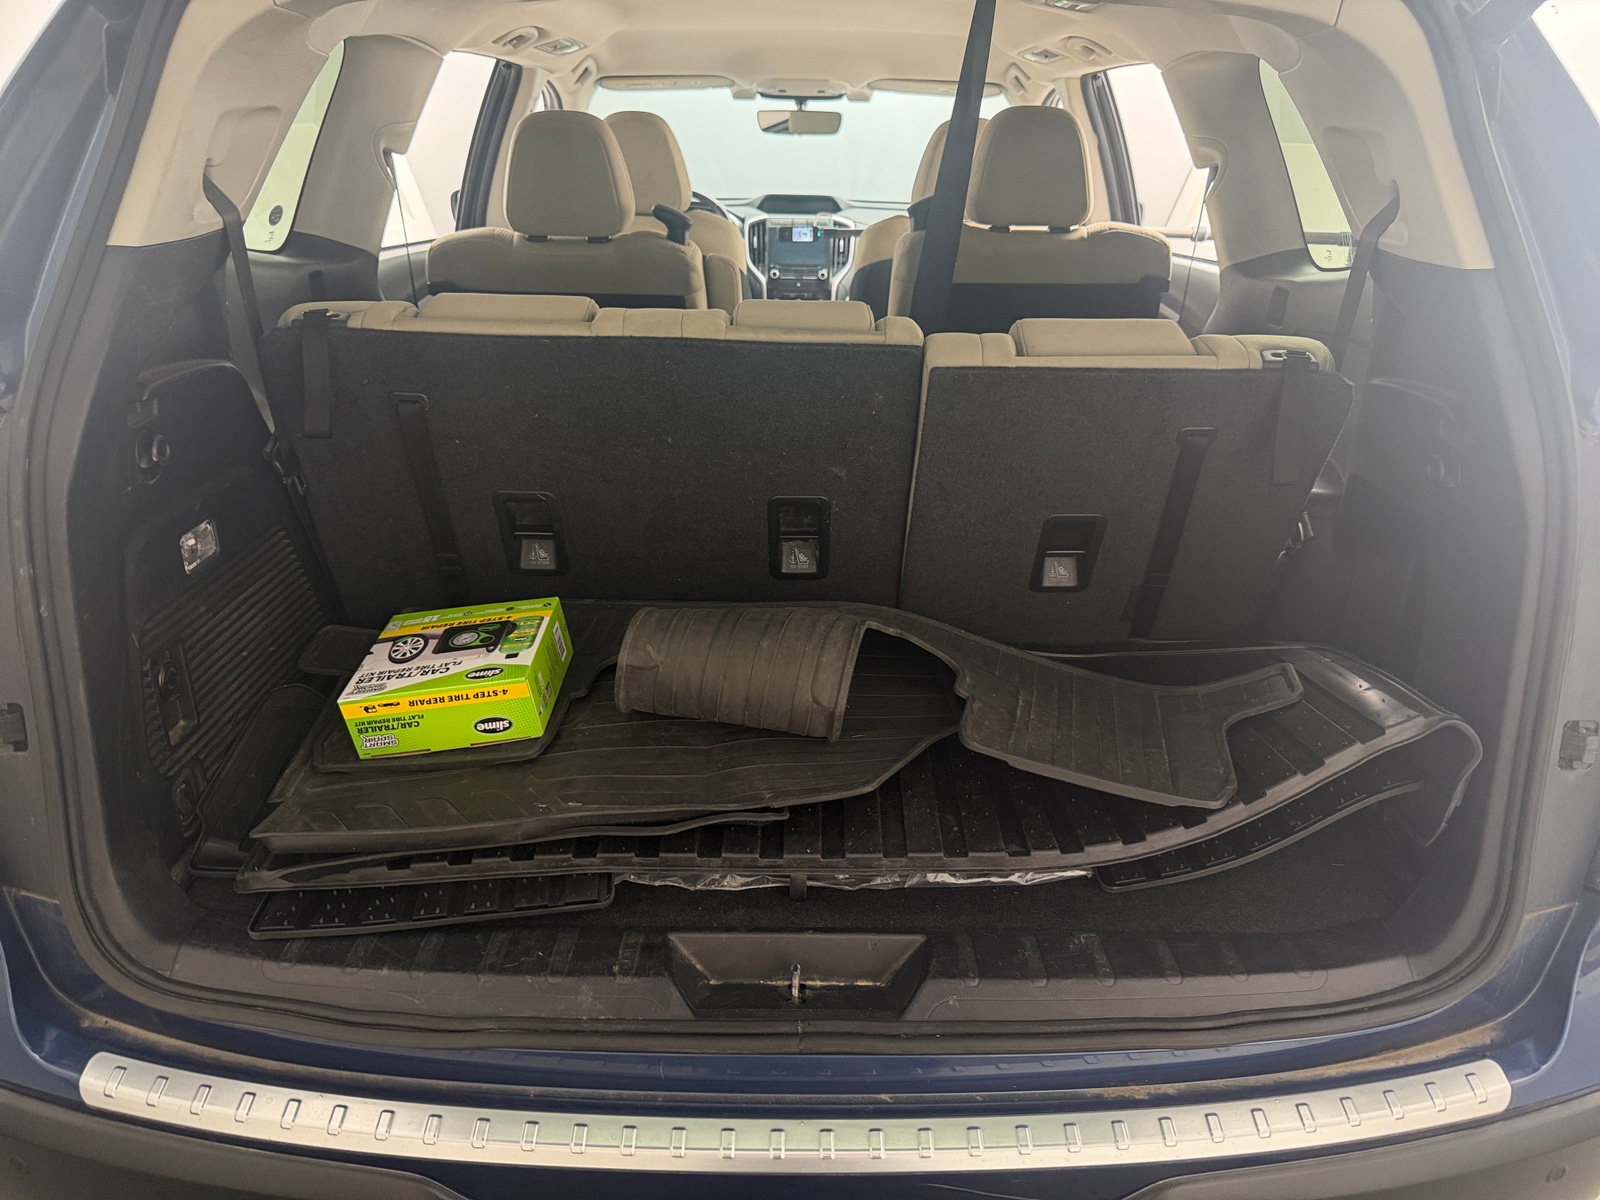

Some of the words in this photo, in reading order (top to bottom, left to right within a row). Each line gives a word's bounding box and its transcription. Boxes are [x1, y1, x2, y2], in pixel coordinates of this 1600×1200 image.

[479, 615, 513, 623] 4-STEP
[420, 622, 455, 631] REPAIR
[414, 663, 437, 672] TIRE
[437, 660, 463, 669] FLAT
[355, 667, 450, 685] CAR/TRAILER
[376, 666, 413, 676] REPAIR
[467, 668, 502, 678] slime
[447, 693, 471, 701] TIRE
[473, 688, 509, 699] 4-STEP
[408, 695, 446, 707] REPAIR
[368, 717, 390, 726] REPAIR
[476, 719, 510, 732] slime
[357, 720, 420, 734] CAR/TRAILER
[363, 739, 399, 750] SMART
